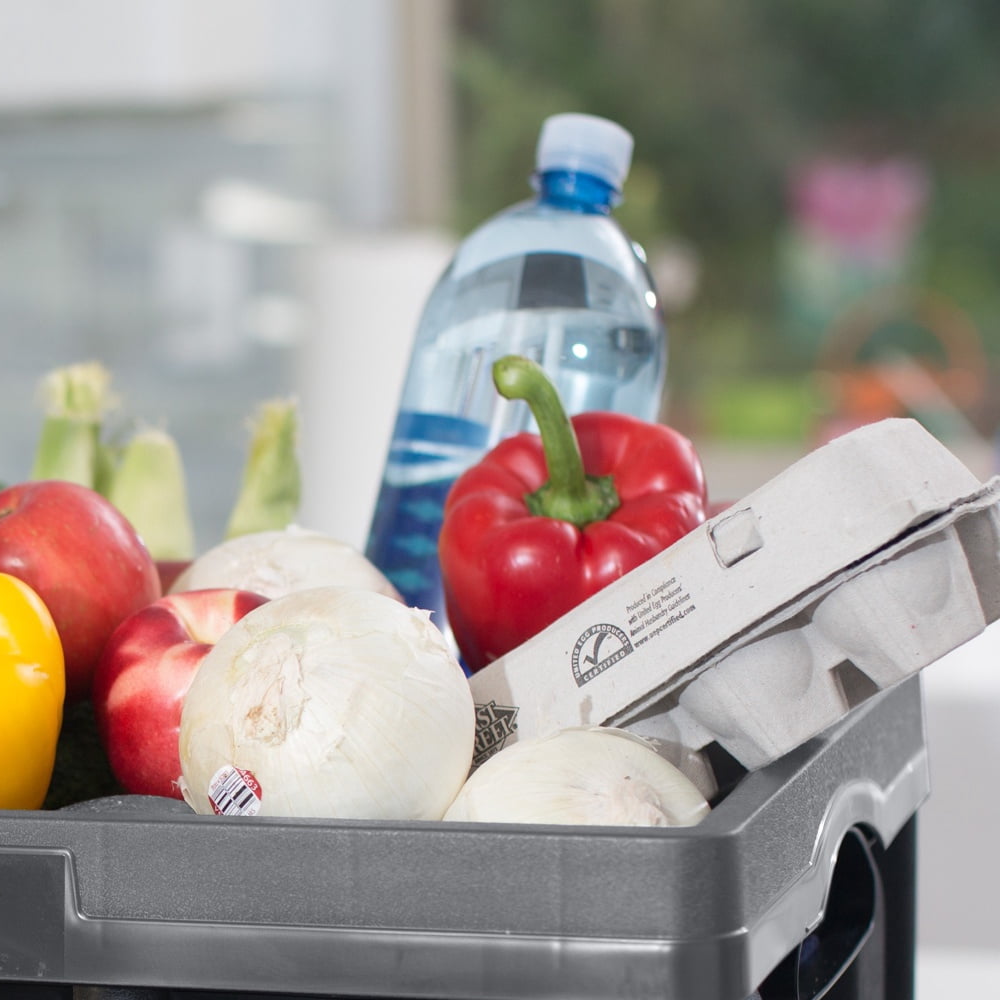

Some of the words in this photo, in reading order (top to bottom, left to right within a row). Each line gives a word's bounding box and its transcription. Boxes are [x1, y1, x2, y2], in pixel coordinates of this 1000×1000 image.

[577, 632, 590, 646] EGG
[591, 625, 630, 647] PRODUCERS
[583, 650, 626, 682] CERTIFIED
